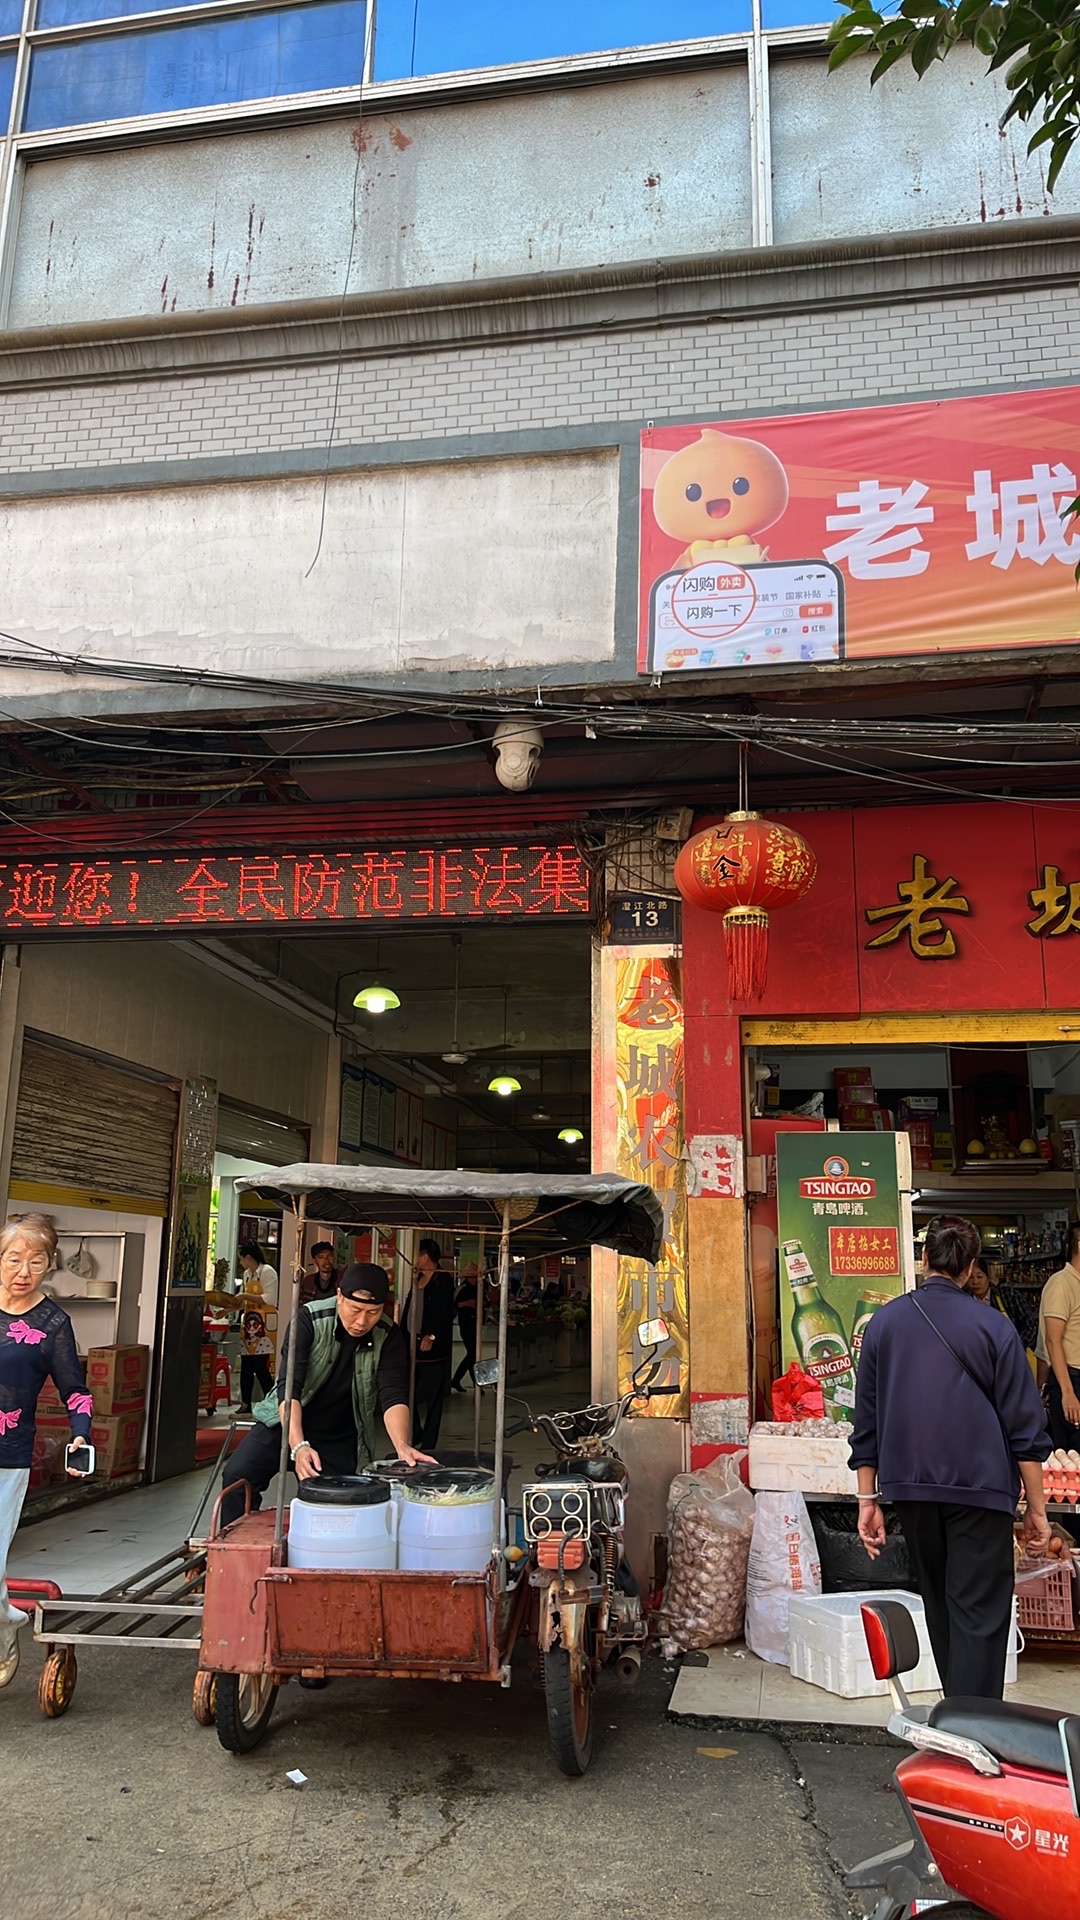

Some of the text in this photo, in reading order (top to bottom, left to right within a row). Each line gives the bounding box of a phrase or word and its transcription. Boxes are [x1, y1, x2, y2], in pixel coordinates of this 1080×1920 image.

[683, 576, 715, 592] 闪购
[720, 577, 742, 588] 外卖
[786, 590, 821, 600] 国家补贴
[687, 604, 742, 620] 闪购一下
[807, 607, 824, 616] 搜索
[774, 627, 788, 635] 订单
[0, 852, 587, 919] 迎您！全民防范非法集
[622, 901, 668, 911] 澄江北路
[631, 911, 659, 927] 13
[804, 1182, 871, 1195] TSINGTAO
[812, 1202, 864, 1215] 青岛啤酒
[836, 1232, 891, 1253] 本店招女工
[835, 1256, 896, 1270] 17336996688
[853, 1337, 862, 1347] TS
[807, 1357, 851, 1377] TSINGTAO
[969, 1819, 1004, 1831] SPORT
[1035, 1828, 1070, 1853] 星光
